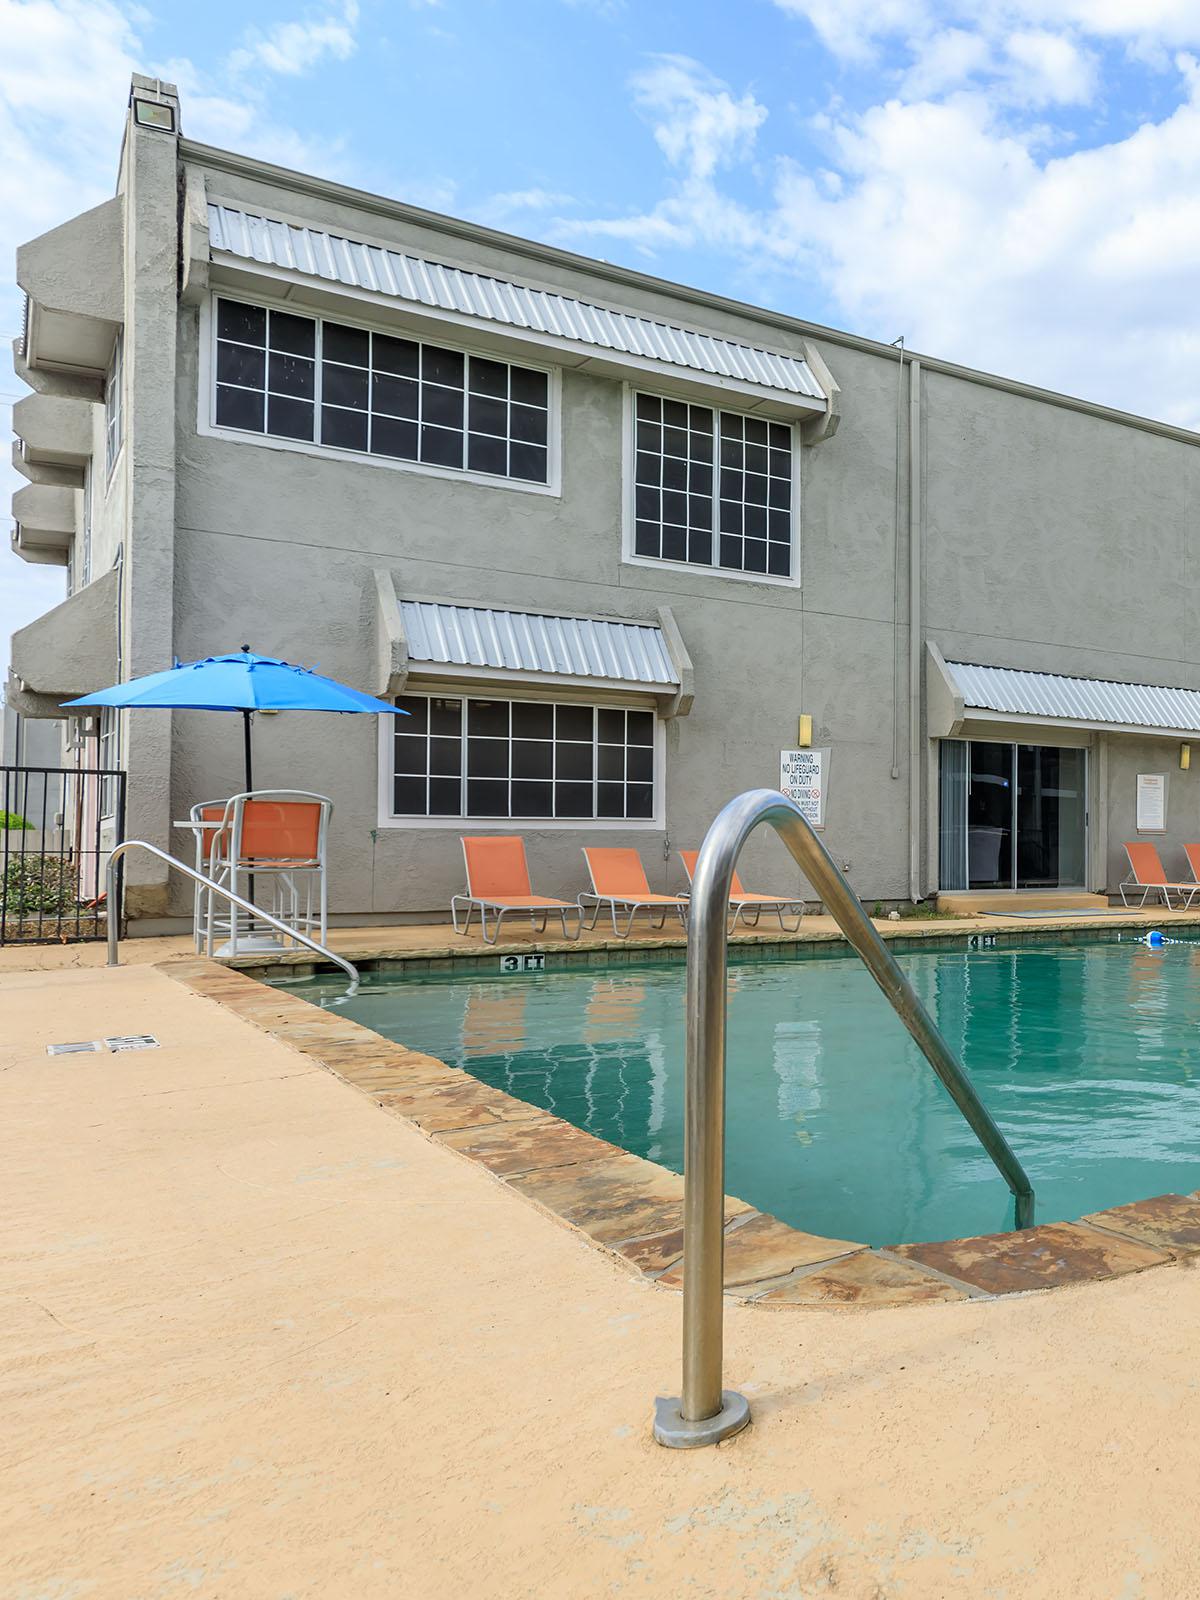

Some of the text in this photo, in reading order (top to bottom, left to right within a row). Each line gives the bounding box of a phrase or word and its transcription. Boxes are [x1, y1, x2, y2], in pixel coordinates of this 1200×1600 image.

[789, 753, 814, 763] WARNING
[782, 763, 820, 775] NO LIFEGUARD
[789, 774, 813, 785] ON DUTY
[798, 789, 811, 799] DIVING
